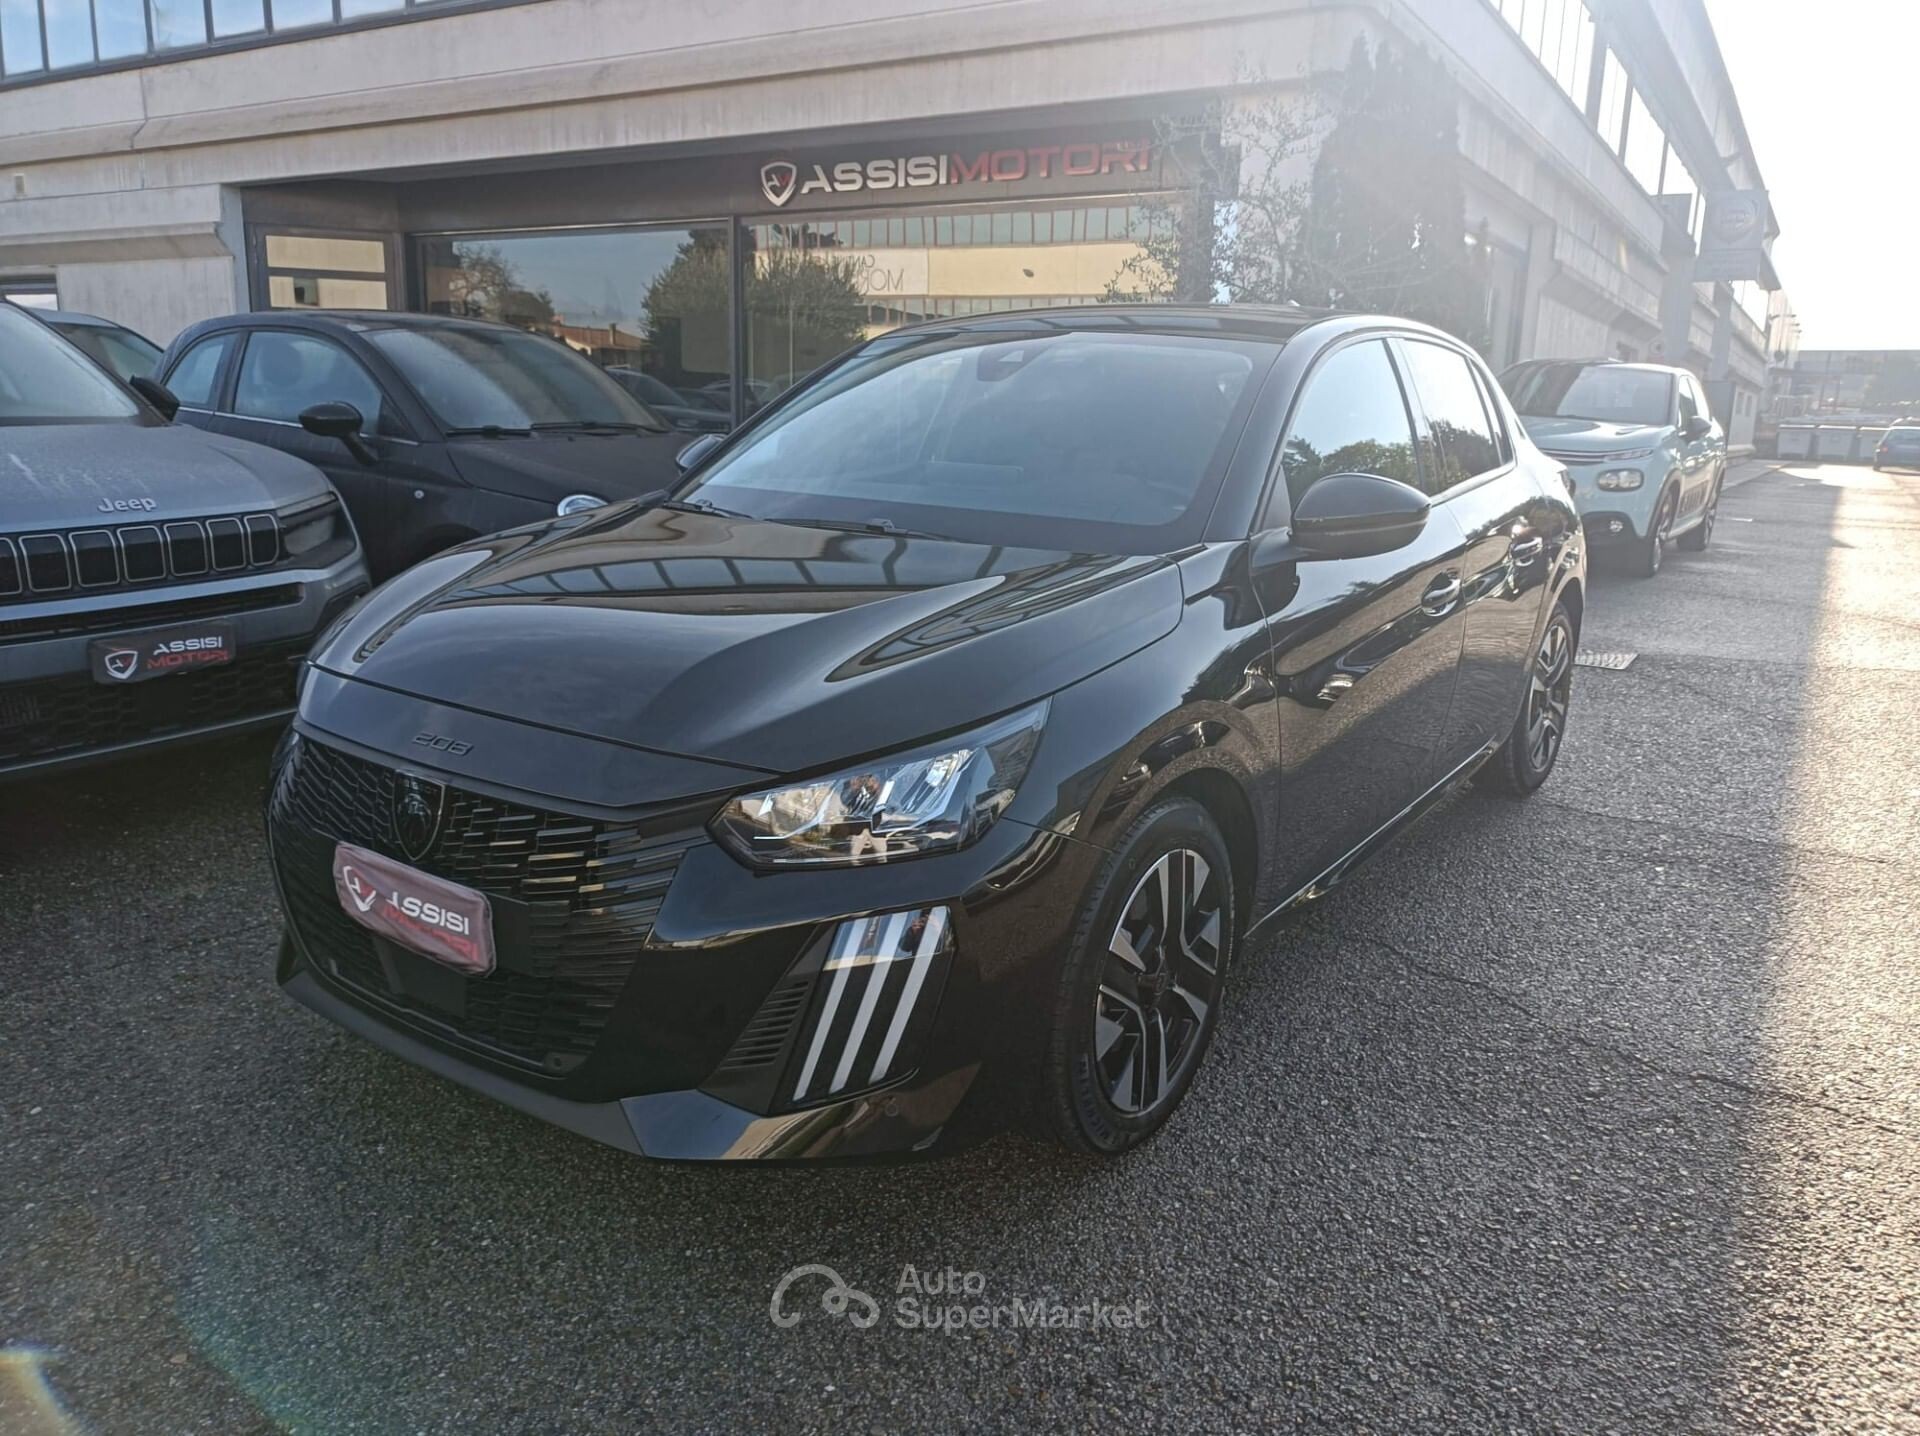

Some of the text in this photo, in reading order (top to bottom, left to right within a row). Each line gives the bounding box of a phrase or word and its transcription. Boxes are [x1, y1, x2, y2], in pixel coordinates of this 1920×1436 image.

[98, 497, 157, 513] Jeep
[153, 636, 223, 656] ASSISI
[412, 731, 475, 756] 208
[386, 891, 469, 936] ASSISI
